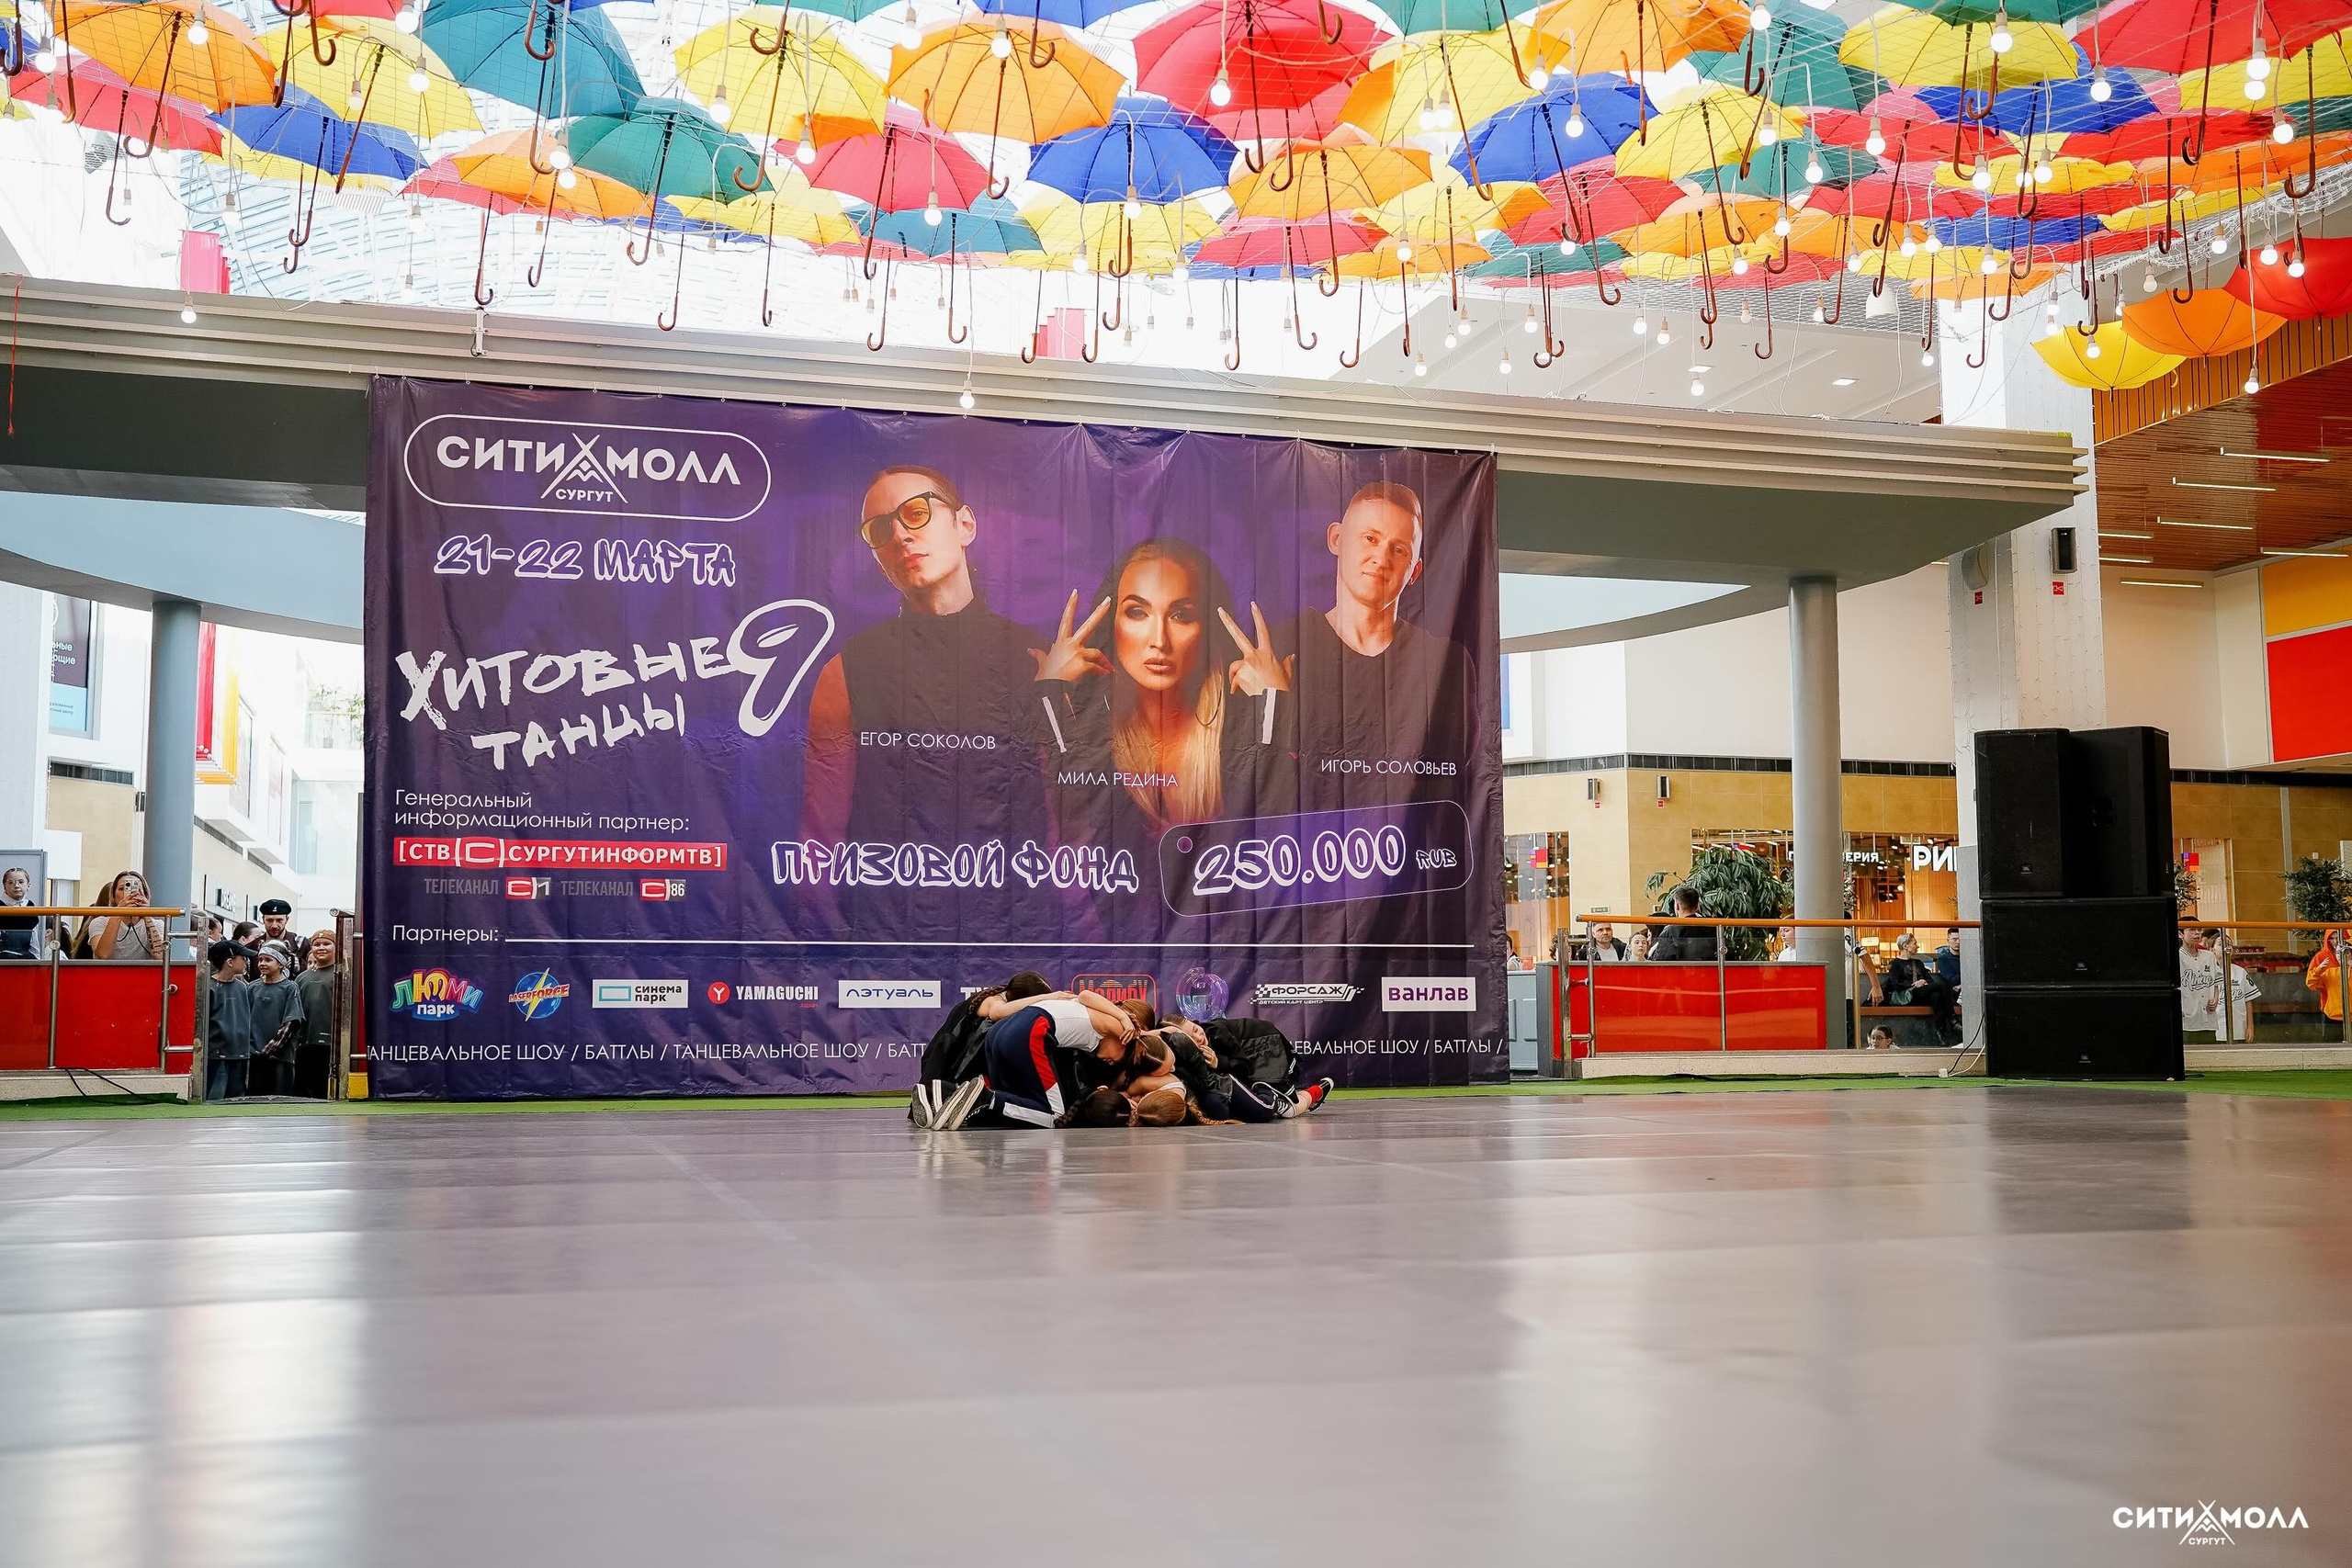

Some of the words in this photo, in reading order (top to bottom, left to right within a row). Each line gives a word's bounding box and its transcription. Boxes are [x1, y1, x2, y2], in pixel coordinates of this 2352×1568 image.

[436, 435, 566, 474] СИТИ
[605, 446, 741, 486] МОЛЛ
[554, 488, 614, 503] СУРГУТ
[433, 534, 584, 581] 21-22
[593, 538, 736, 588] МАРТА
[469, 692, 686, 772] ТАНЦЫ
[859, 731, 903, 748] ЕГОР
[906, 733, 997, 750] СОКОЛОВ
[1320, 759, 1373, 774] ИГОРЬ
[1375, 760, 1458, 776] СОЛОВЬЕВ
[1057, 771, 1109, 786] МИЛА
[1113, 772, 1180, 788] РЕДИНА
[395, 789, 533, 809] Генеральный
[394, 809, 593, 830] информационный
[598, 815, 690, 832] партнер:
[771, 840, 1005, 888] ПРИЗОВОЙ
[1011, 840, 1140, 894] ФОНД
[1193, 824, 1407, 896] 250.000
[1415, 848, 1459, 870] RUB
[1913, 845, 1958, 872] РИ
[424, 878, 500, 895] ТЕЛЕКАНАЛ
[560, 880, 634, 897] ТЕЛЕКАНАЛ
[392, 925, 499, 943] Партнеры:
[508, 984, 571, 1003] LASERFORCE
[635, 994, 666, 1004] парк
[735, 986, 819, 1000] YAMAGUCHI
[1272, 987, 1343, 995] ФОРСАЖ
[1388, 987, 1469, 1001] ванлав
[416, 1003, 456, 1018] парк
[517, 1044, 566, 1061] ШОУ
[585, 1044, 654, 1060] БАТТЛЫ
[673, 1043, 819, 1061] ТАНЦЕВАЛЬНОЕ
[824, 1043, 870, 1059] ШОУ
[888, 1043, 927, 1057] БАТТ
[1290, 1040, 1376, 1055] ЕВАЛЬНОЕ
[1381, 1039, 1419, 1054] ШОУ
[1434, 1039, 1491, 1054] БАТТЛЫ
